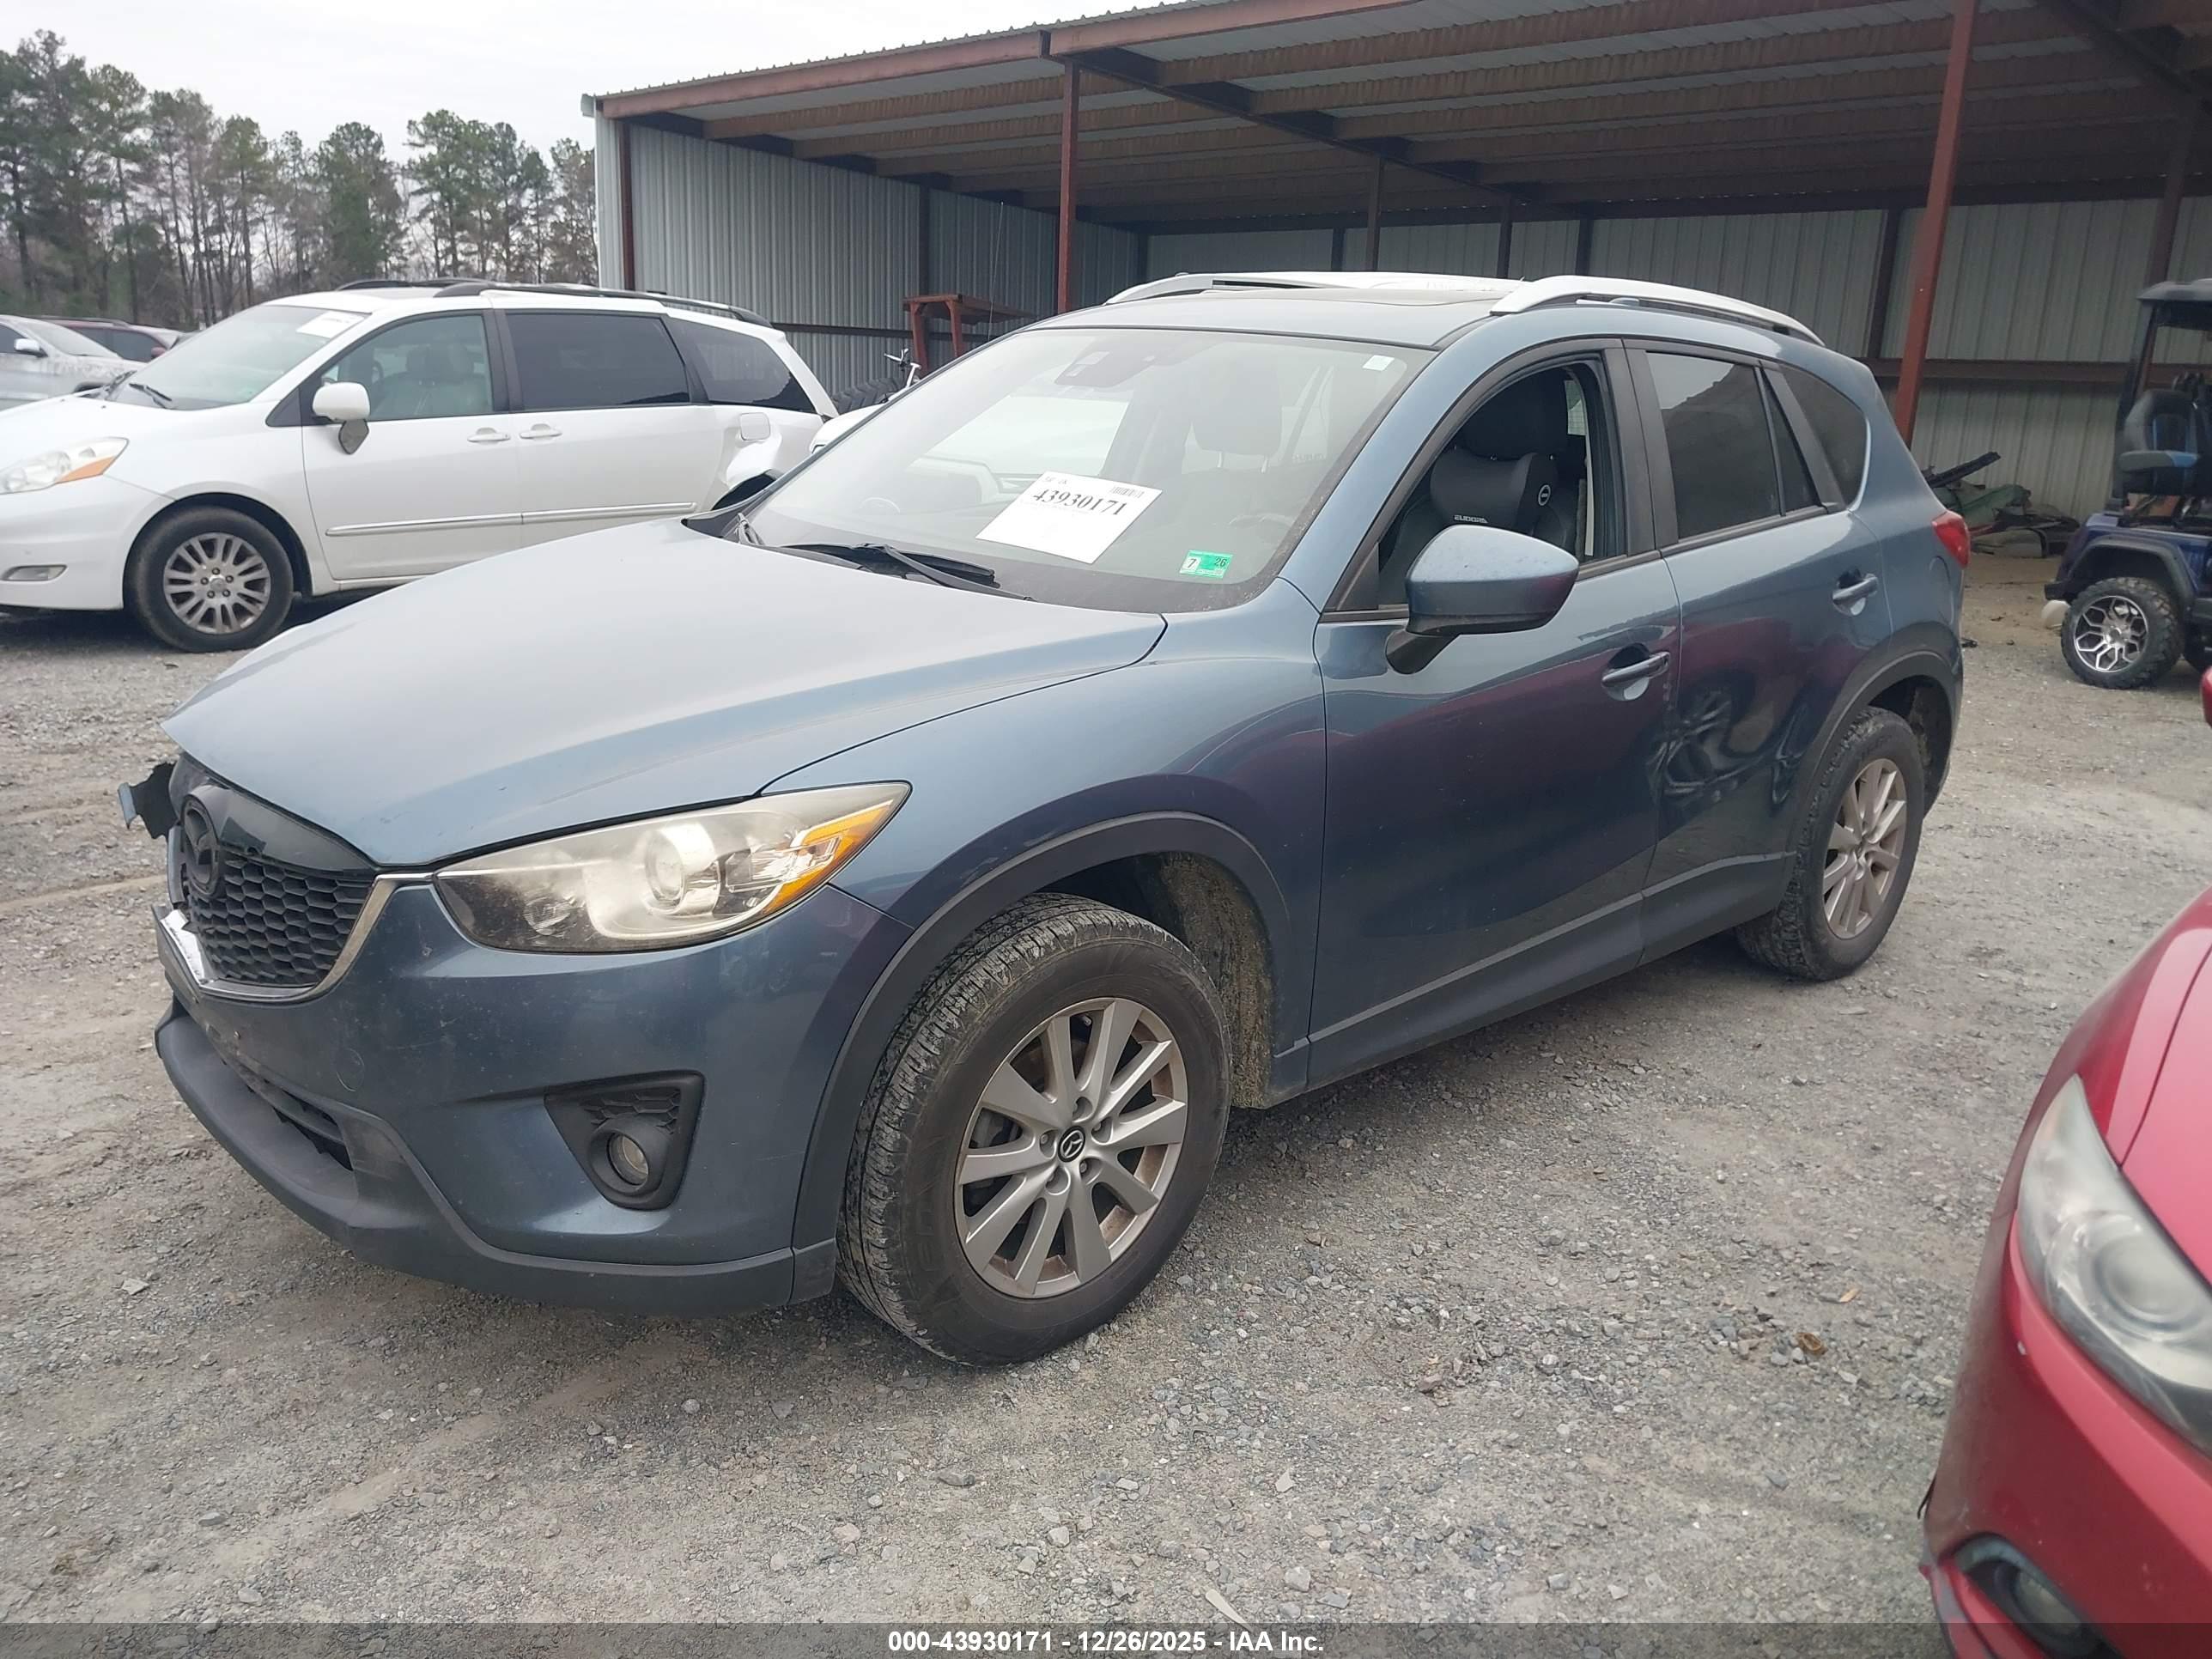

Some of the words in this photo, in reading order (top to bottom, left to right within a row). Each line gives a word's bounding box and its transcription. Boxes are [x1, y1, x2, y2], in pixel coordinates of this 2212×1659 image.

[1033, 489, 1127, 515] 43930171
[1188, 558, 1197, 568] 7
[1213, 558, 1228, 568] 26
